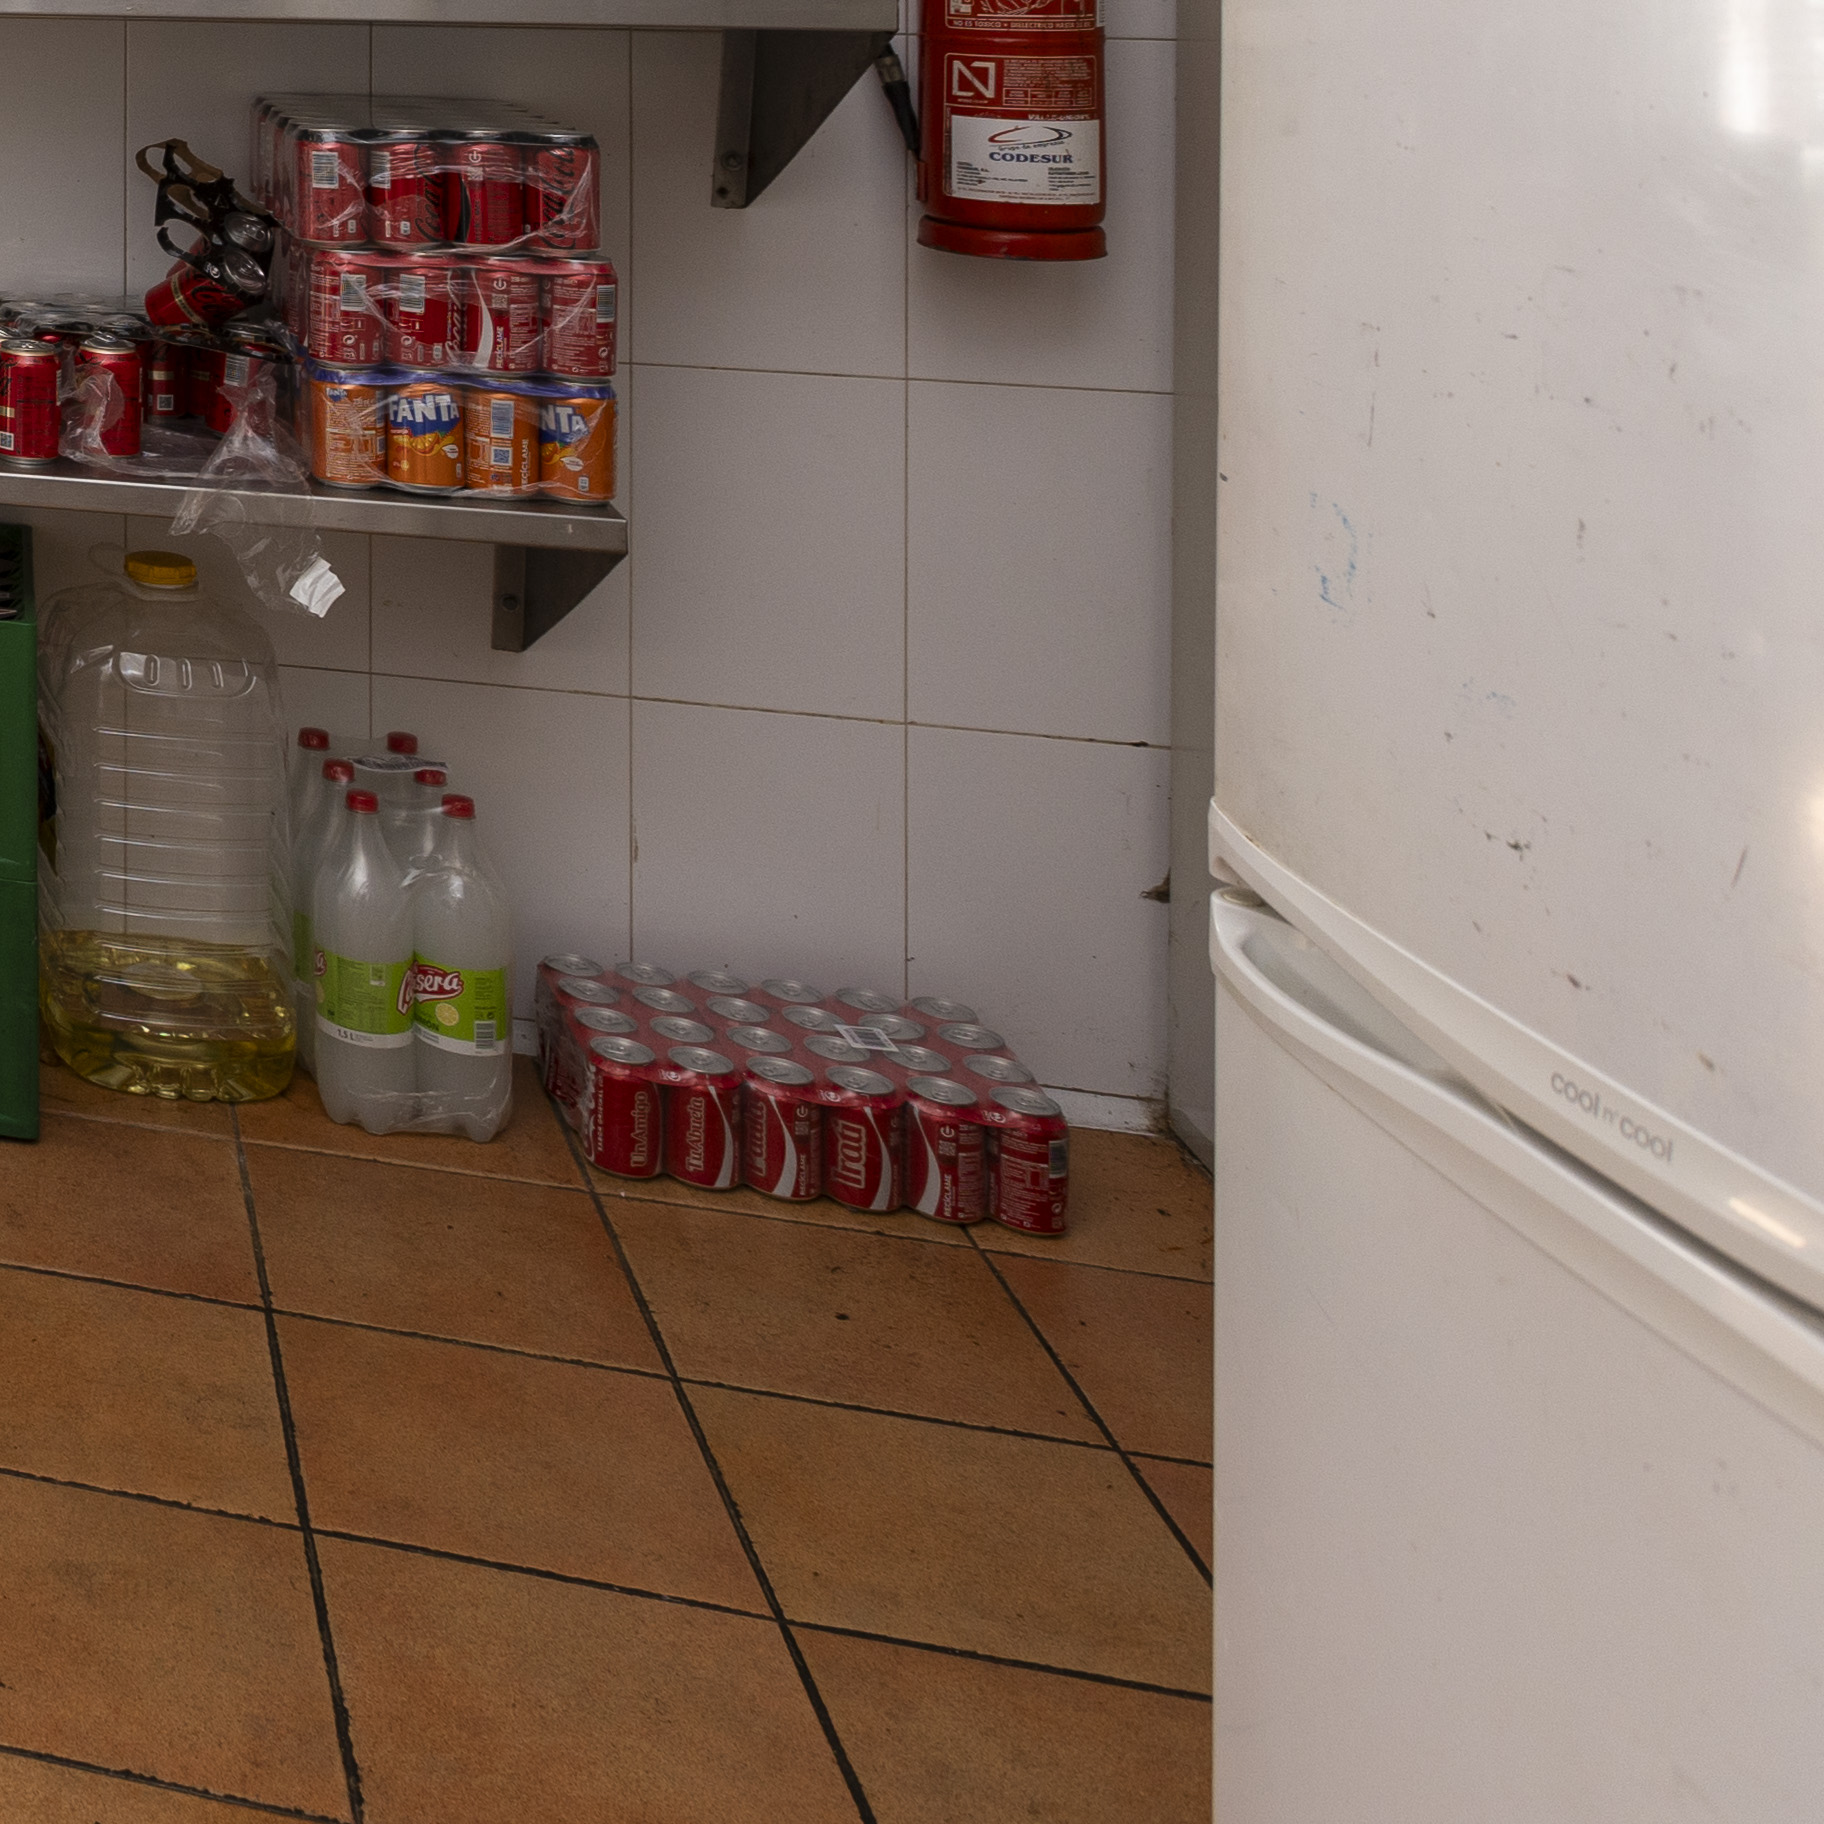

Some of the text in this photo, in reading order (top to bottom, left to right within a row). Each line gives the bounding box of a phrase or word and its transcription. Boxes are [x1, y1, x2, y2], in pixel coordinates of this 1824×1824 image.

[988, 151, 1074, 164] CODESUR
[388, 393, 461, 425] FANTA
[1551, 1073, 1674, 1165] cool cool
